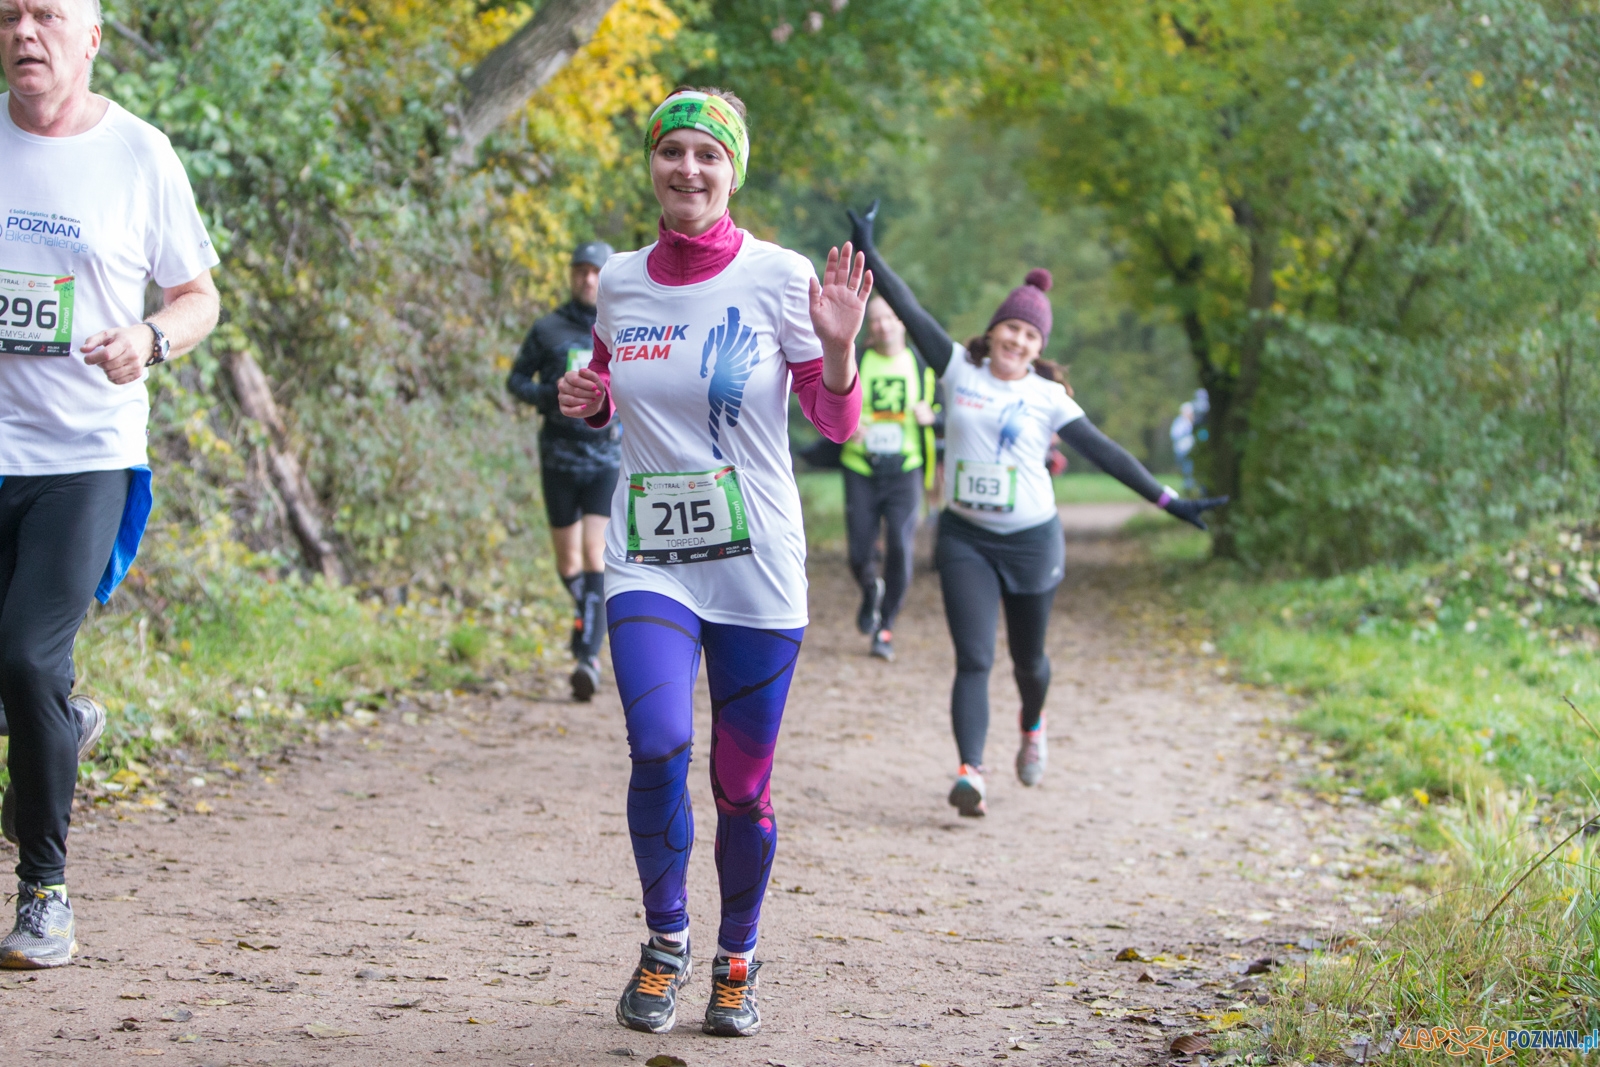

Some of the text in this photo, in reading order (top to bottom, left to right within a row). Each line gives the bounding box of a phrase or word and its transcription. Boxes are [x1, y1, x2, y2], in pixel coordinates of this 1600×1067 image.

[5, 229, 89, 253] BikeChallenge
[613, 324, 690, 346] HERNIK
[615, 343, 672, 363] TEAM
[967, 476, 1000, 496] 163
[652, 499, 715, 536] 215
[666, 537, 706, 548] TORPEDA
